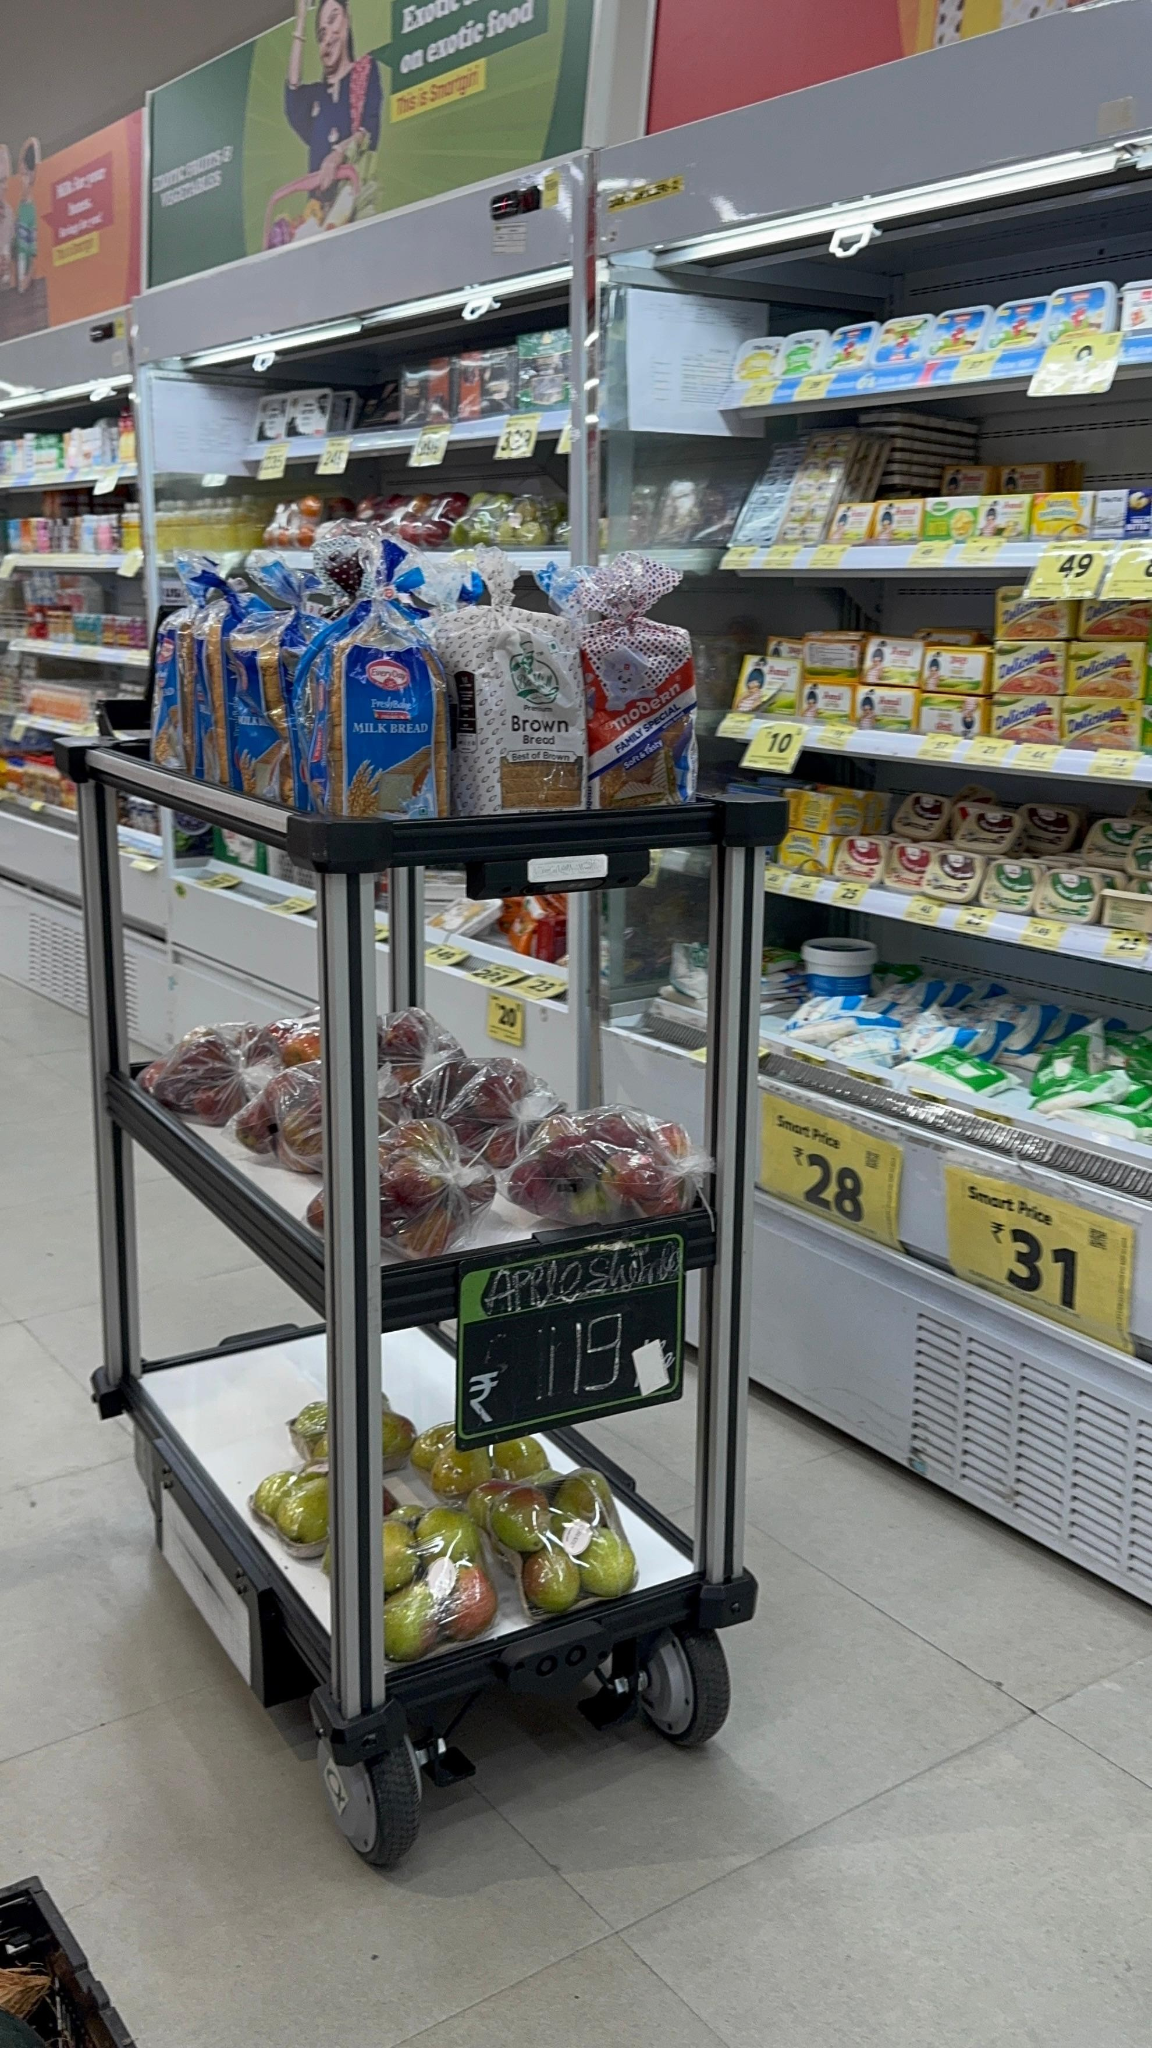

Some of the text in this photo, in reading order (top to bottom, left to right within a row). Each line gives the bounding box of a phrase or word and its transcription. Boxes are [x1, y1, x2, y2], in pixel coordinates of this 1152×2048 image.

[400, 0, 534, 74] on exotic food
[1057, 553, 1093, 578] 49
[523, 705, 553, 713] Premium
[353, 722, 428, 734] MILK BREAD
[511, 715, 569, 733] Brown
[615, 728, 644, 754] FAMILY
[642, 702, 681, 733] SPECIAL
[522, 735, 555, 745] Bread
[768, 732, 793, 753] 10
[511, 751, 570, 762] Best of Brown
[623, 755, 639, 770] Soft
[528, 978, 555, 992] 23
[776, 1114, 841, 1150] Smart Price
[967, 1185, 1053, 1226] Smart Price
[548, 1312, 622, 1397] 119
